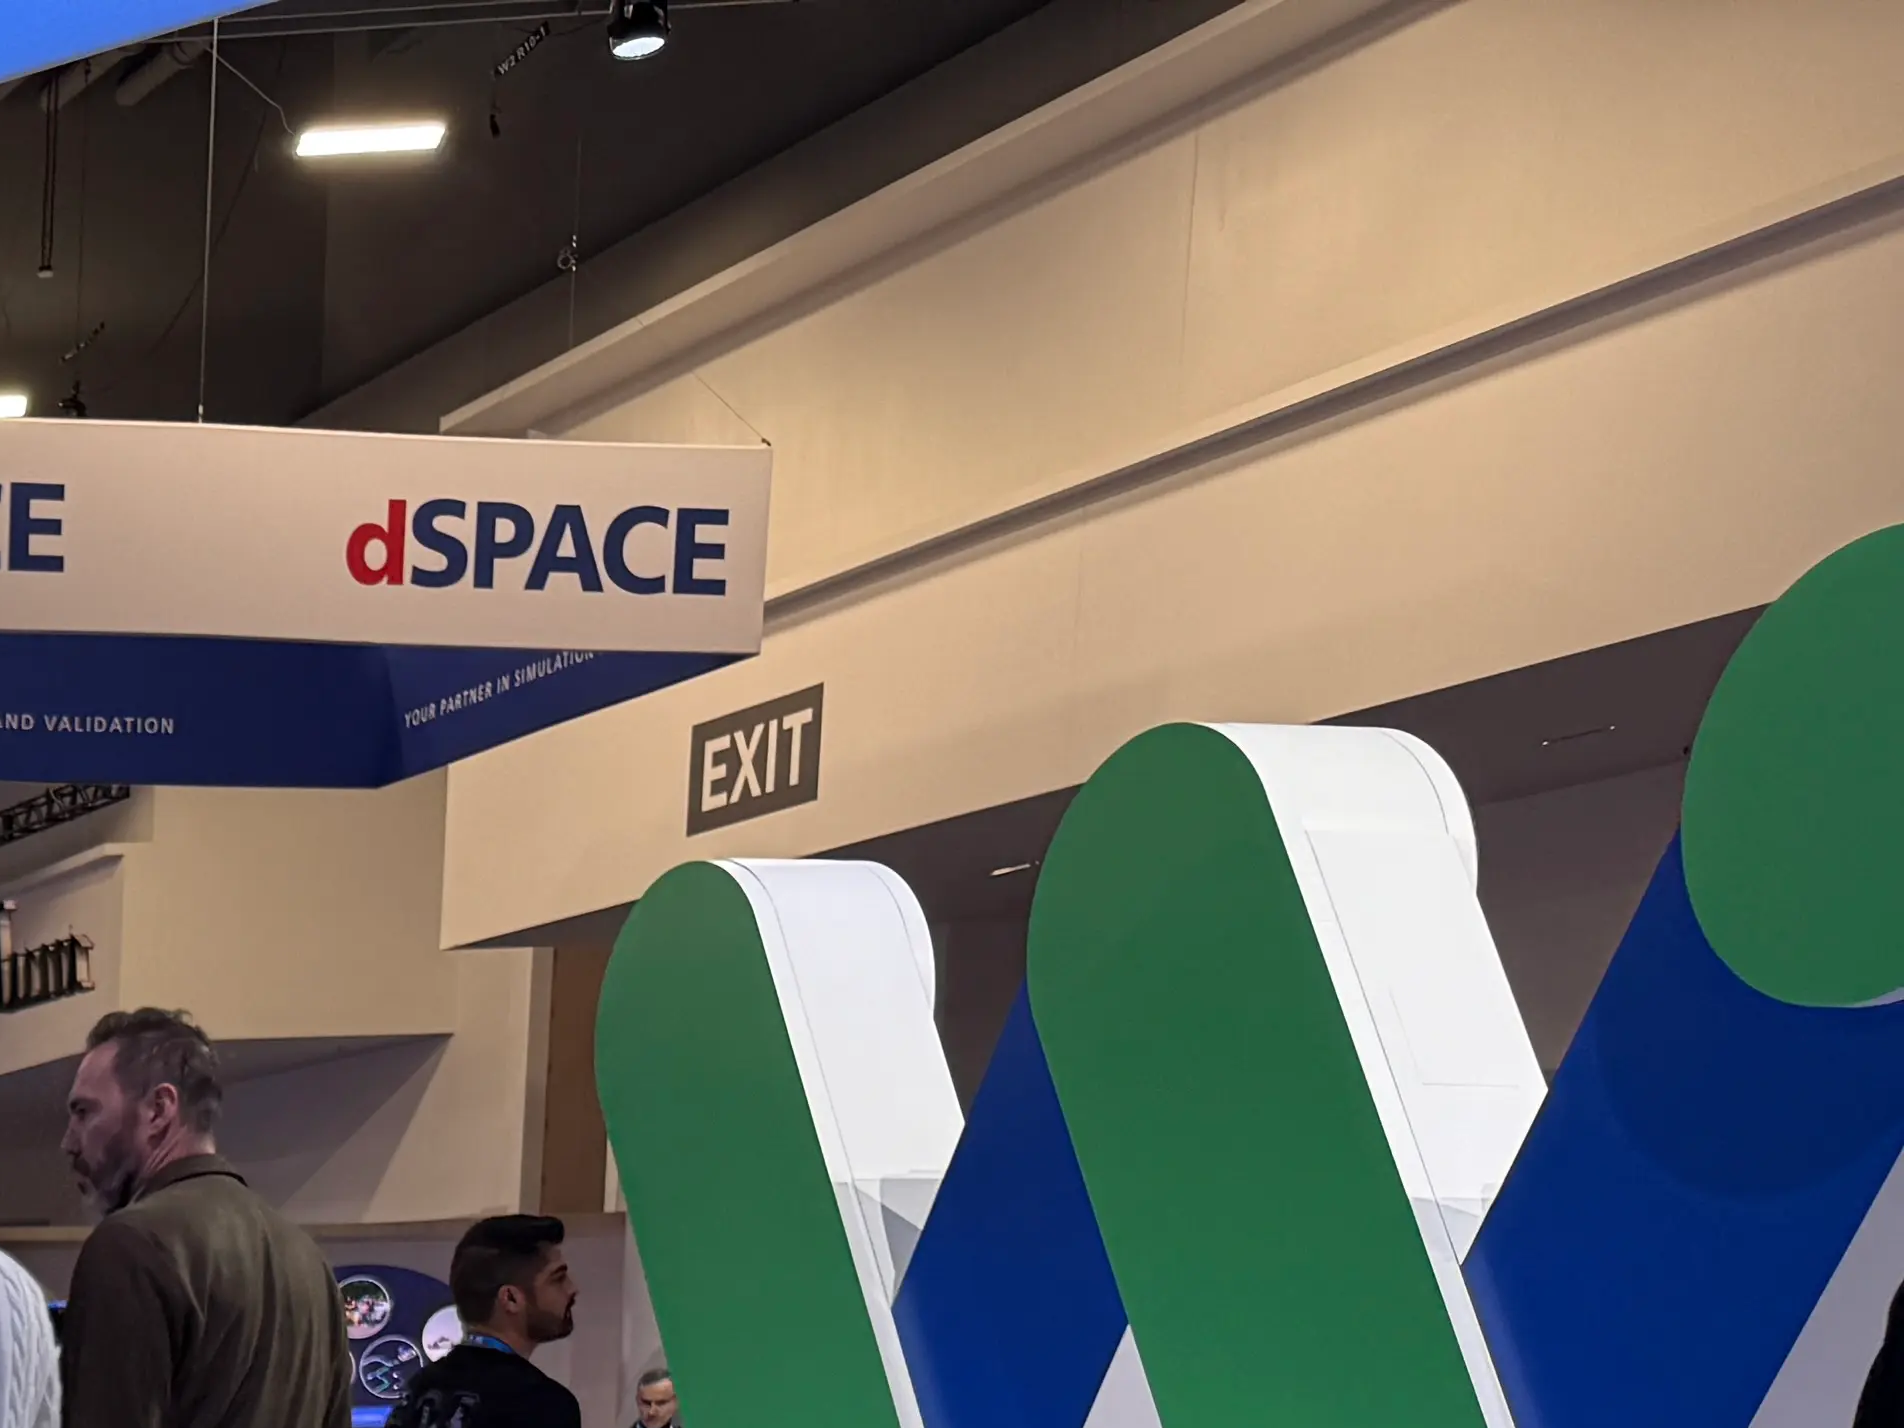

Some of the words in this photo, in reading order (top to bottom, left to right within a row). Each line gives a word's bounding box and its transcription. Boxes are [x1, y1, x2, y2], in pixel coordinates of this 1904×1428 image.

[345, 498, 731, 596] dSPACE
[44, 713, 175, 735] VALIDATION
[404, 702, 436, 729] YOUR
[439, 682, 493, 716] PARTNER
[496, 675, 510, 694] IN
[701, 709, 814, 813] EXIT
